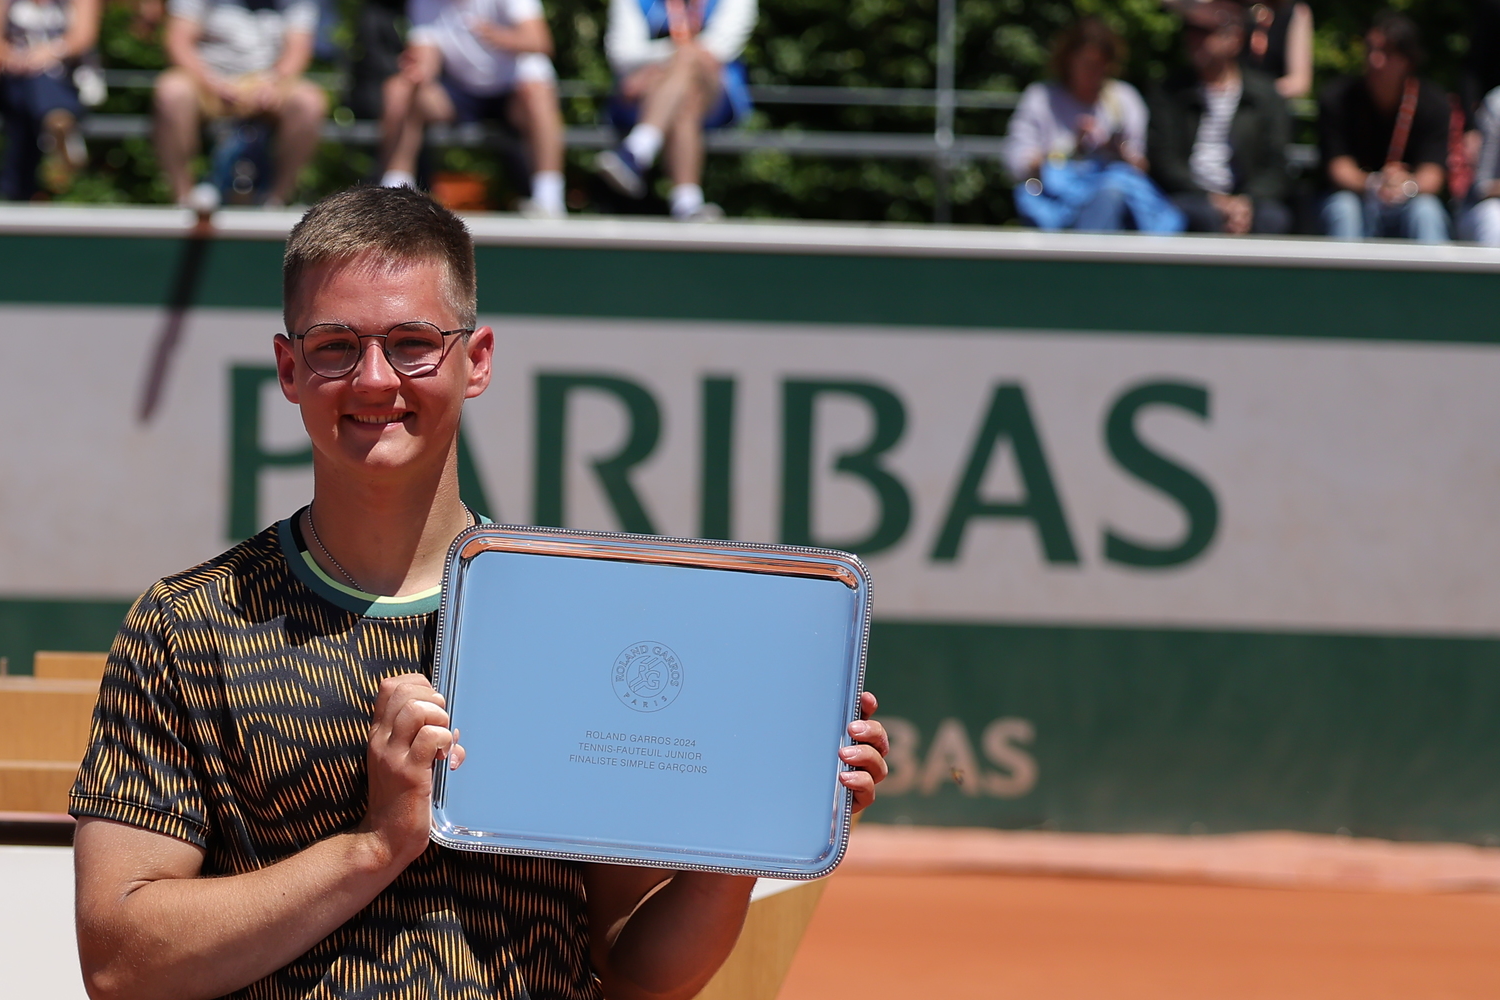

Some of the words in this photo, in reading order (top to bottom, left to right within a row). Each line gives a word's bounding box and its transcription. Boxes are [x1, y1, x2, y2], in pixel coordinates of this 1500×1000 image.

[226, 363, 1221, 570] PRIBAS
[615, 645, 649, 682] ROLAND
[652, 646, 680, 687] GARROS
[623, 692, 667, 708] PARIS
[585, 730, 627, 741] ROLAND
[629, 734, 671, 746] GARROS
[673, 738, 696, 747] 2024
[578, 742, 662, 757] TENNIS-FAUTEUIL
[664, 750, 702, 760] JUNIOR
[569, 754, 618, 766] FINALISTE
[620, 759, 655, 769] SIMPLE
[658, 762, 708, 774] GARÇONS
